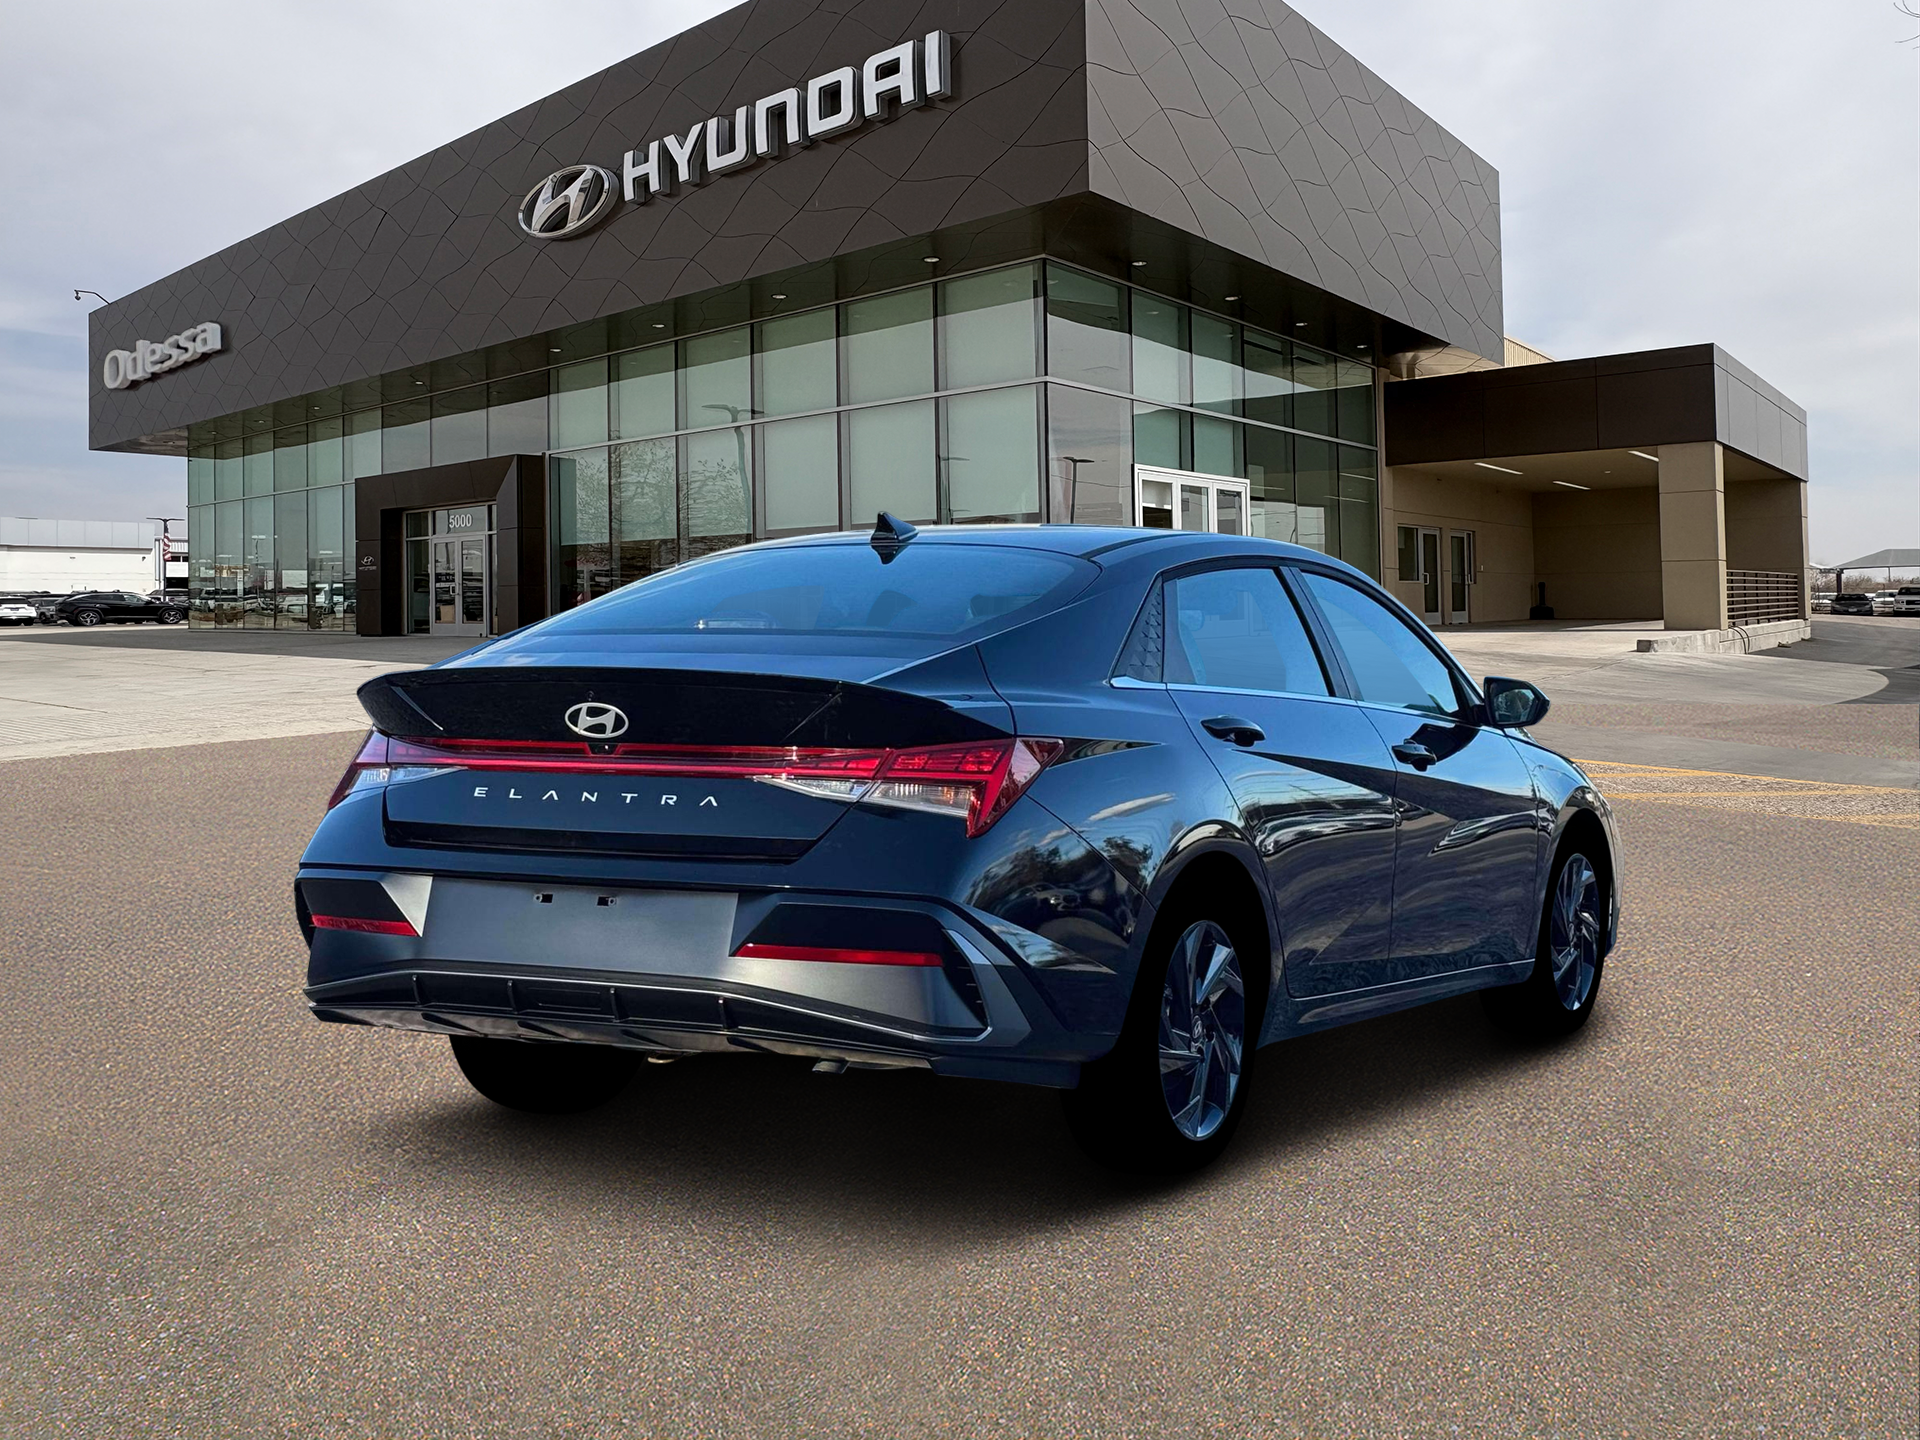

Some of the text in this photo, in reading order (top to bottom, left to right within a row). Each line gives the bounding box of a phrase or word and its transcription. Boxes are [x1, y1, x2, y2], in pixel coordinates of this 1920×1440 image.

[623, 29, 950, 203] HYUNDAI
[103, 321, 222, 389] Odessa
[449, 513, 472, 528] 5000
[473, 787, 718, 807] ELANTRA
